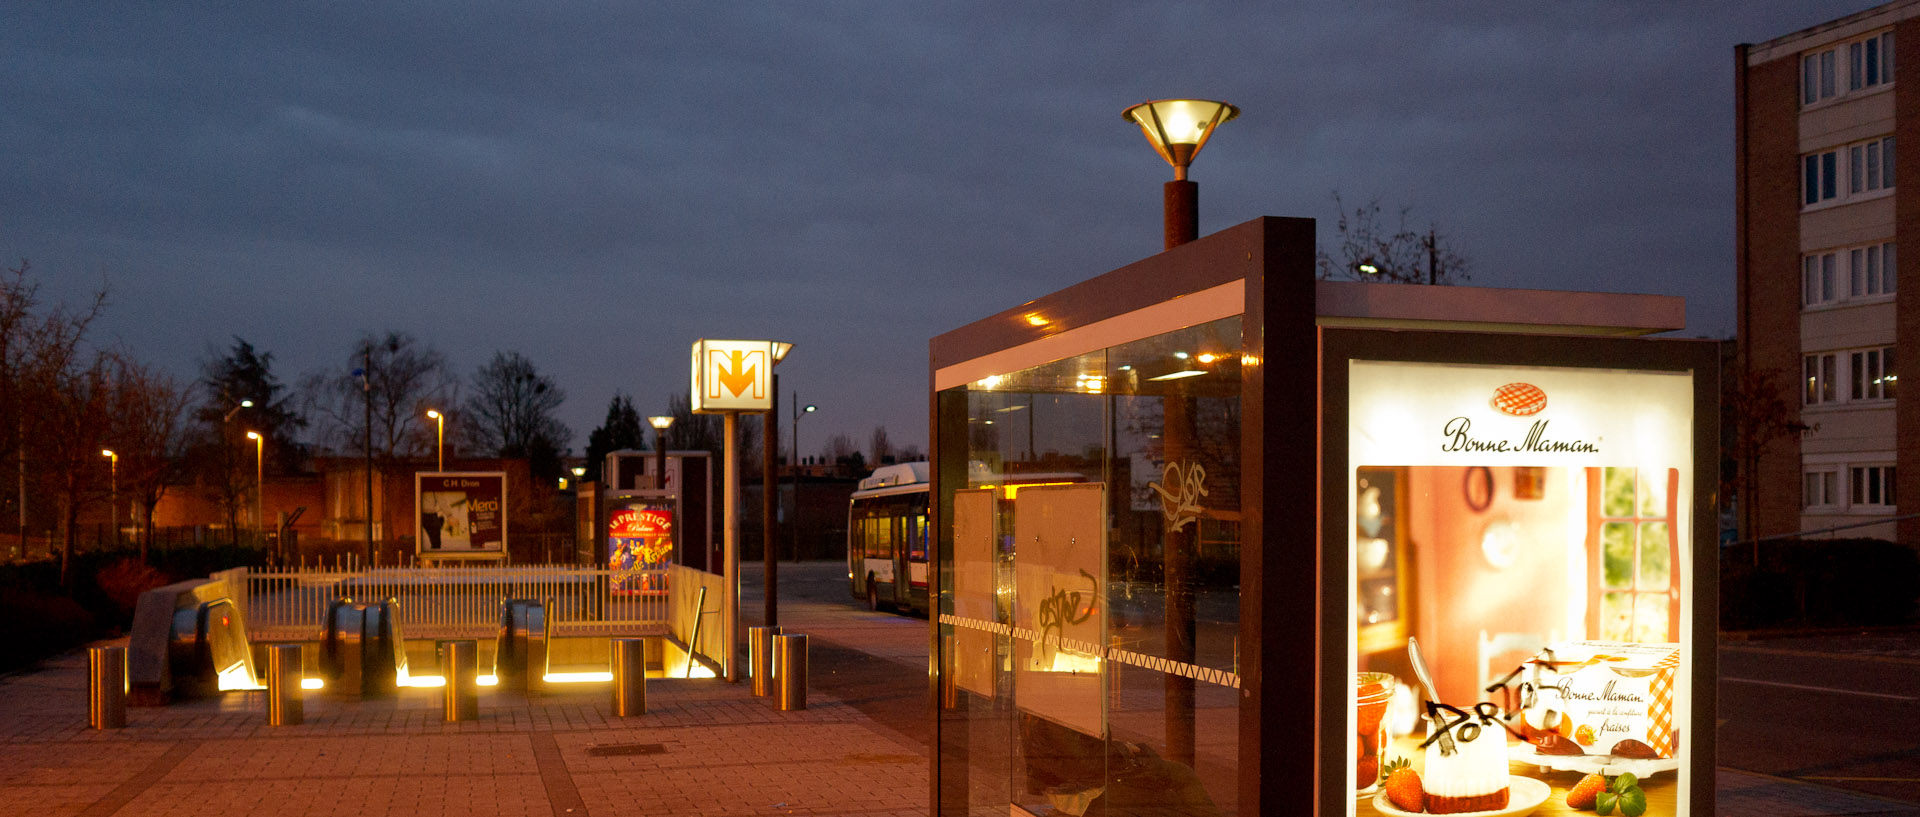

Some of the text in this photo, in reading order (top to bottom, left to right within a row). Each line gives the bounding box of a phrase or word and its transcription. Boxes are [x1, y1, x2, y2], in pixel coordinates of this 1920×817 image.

[1442, 417, 1599, 453] Bonne Maman
[466, 497, 499, 513] Merci
[617, 512, 672, 530] PRESTIGE
[1555, 677, 1643, 702] Bonne Maman
[1600, 718, 1630, 737] fraises
